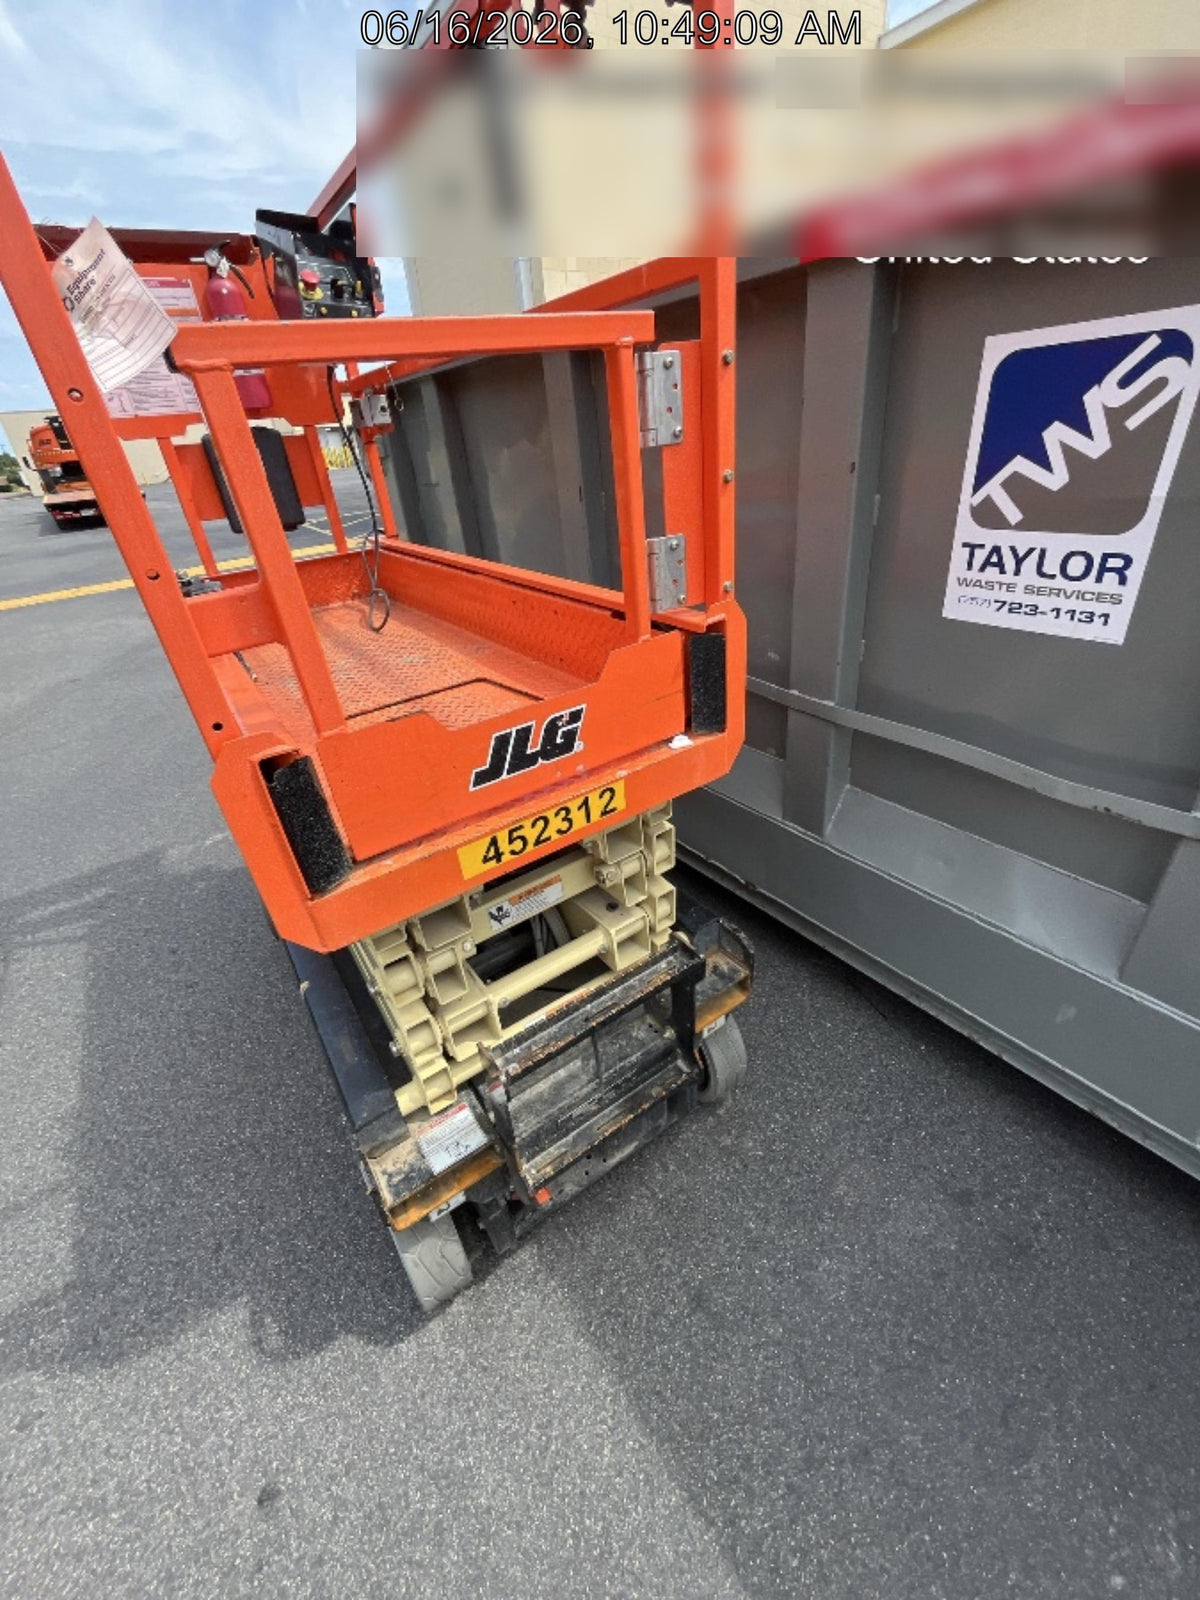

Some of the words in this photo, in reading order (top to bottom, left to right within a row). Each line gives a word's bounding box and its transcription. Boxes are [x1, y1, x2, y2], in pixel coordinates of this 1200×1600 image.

[970, 333, 1193, 527] TWS
[956, 576, 1018, 594] WASTE
[1023, 584, 1124, 606] SERVICES
[961, 541, 1134, 587] TAYLOR
[469, 703, 586, 792] JLG
[481, 787, 618, 864] 452312
